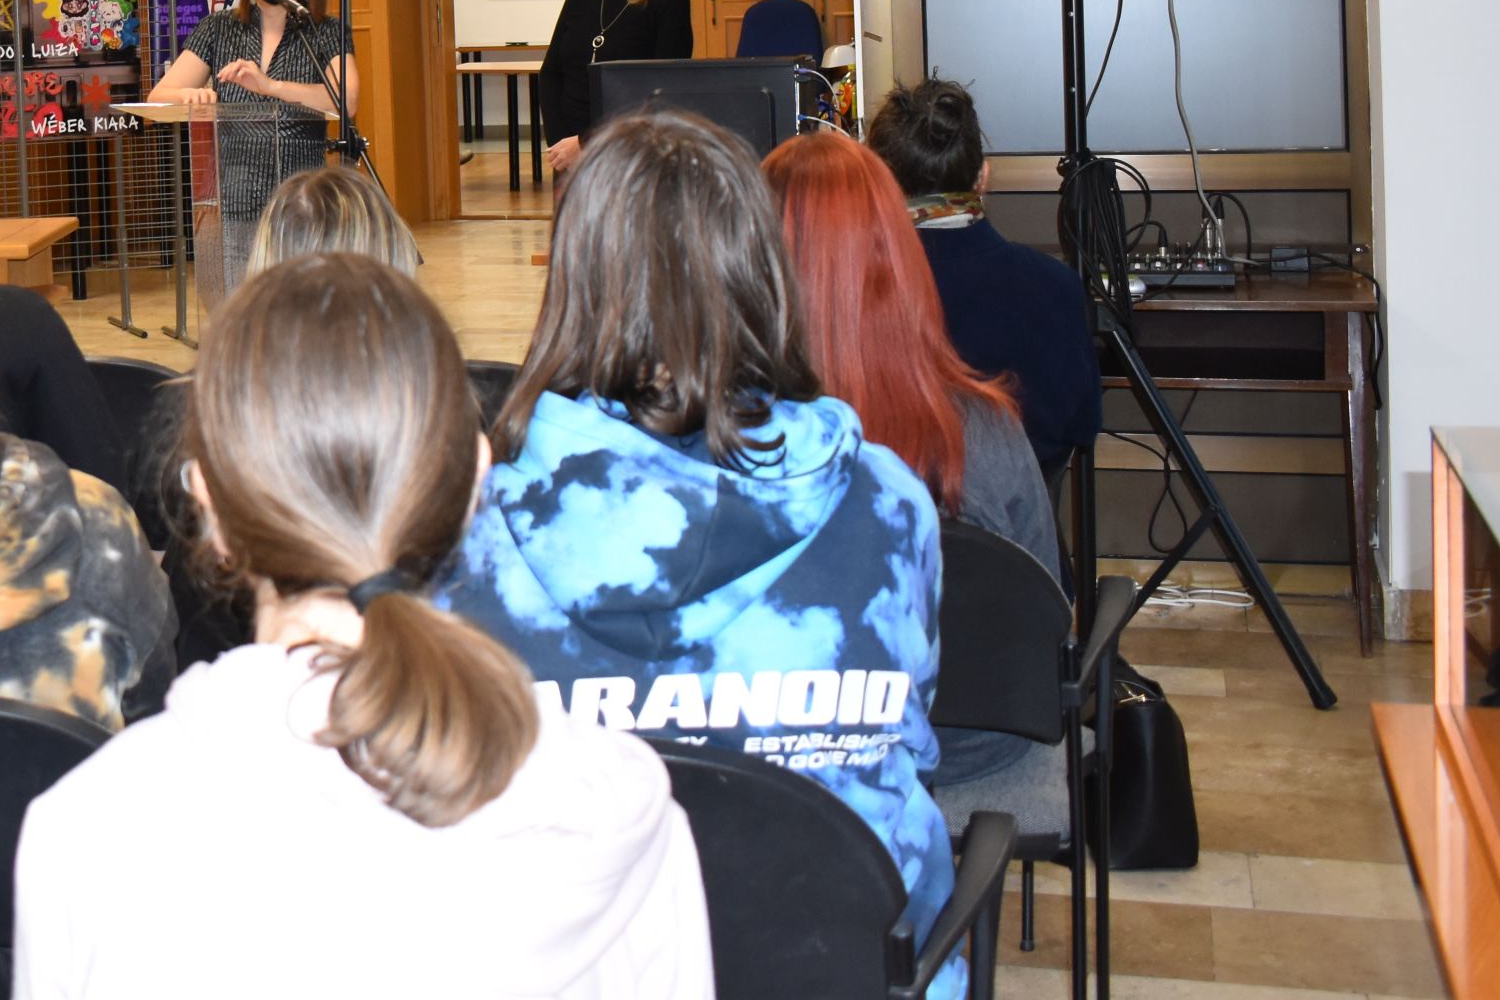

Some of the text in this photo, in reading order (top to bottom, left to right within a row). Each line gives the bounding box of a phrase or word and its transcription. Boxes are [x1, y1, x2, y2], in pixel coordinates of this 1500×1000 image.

[157, 4, 203, 15] üeges
[160, 15, 200, 24] Drina
[32, 42, 79, 59] LUIZA
[31, 114, 87, 137] WÉBER
[94, 115, 139, 134] KIARA
[532, 669, 910, 731] ARANOID
[743, 733, 902, 753] ESTABLISHED
